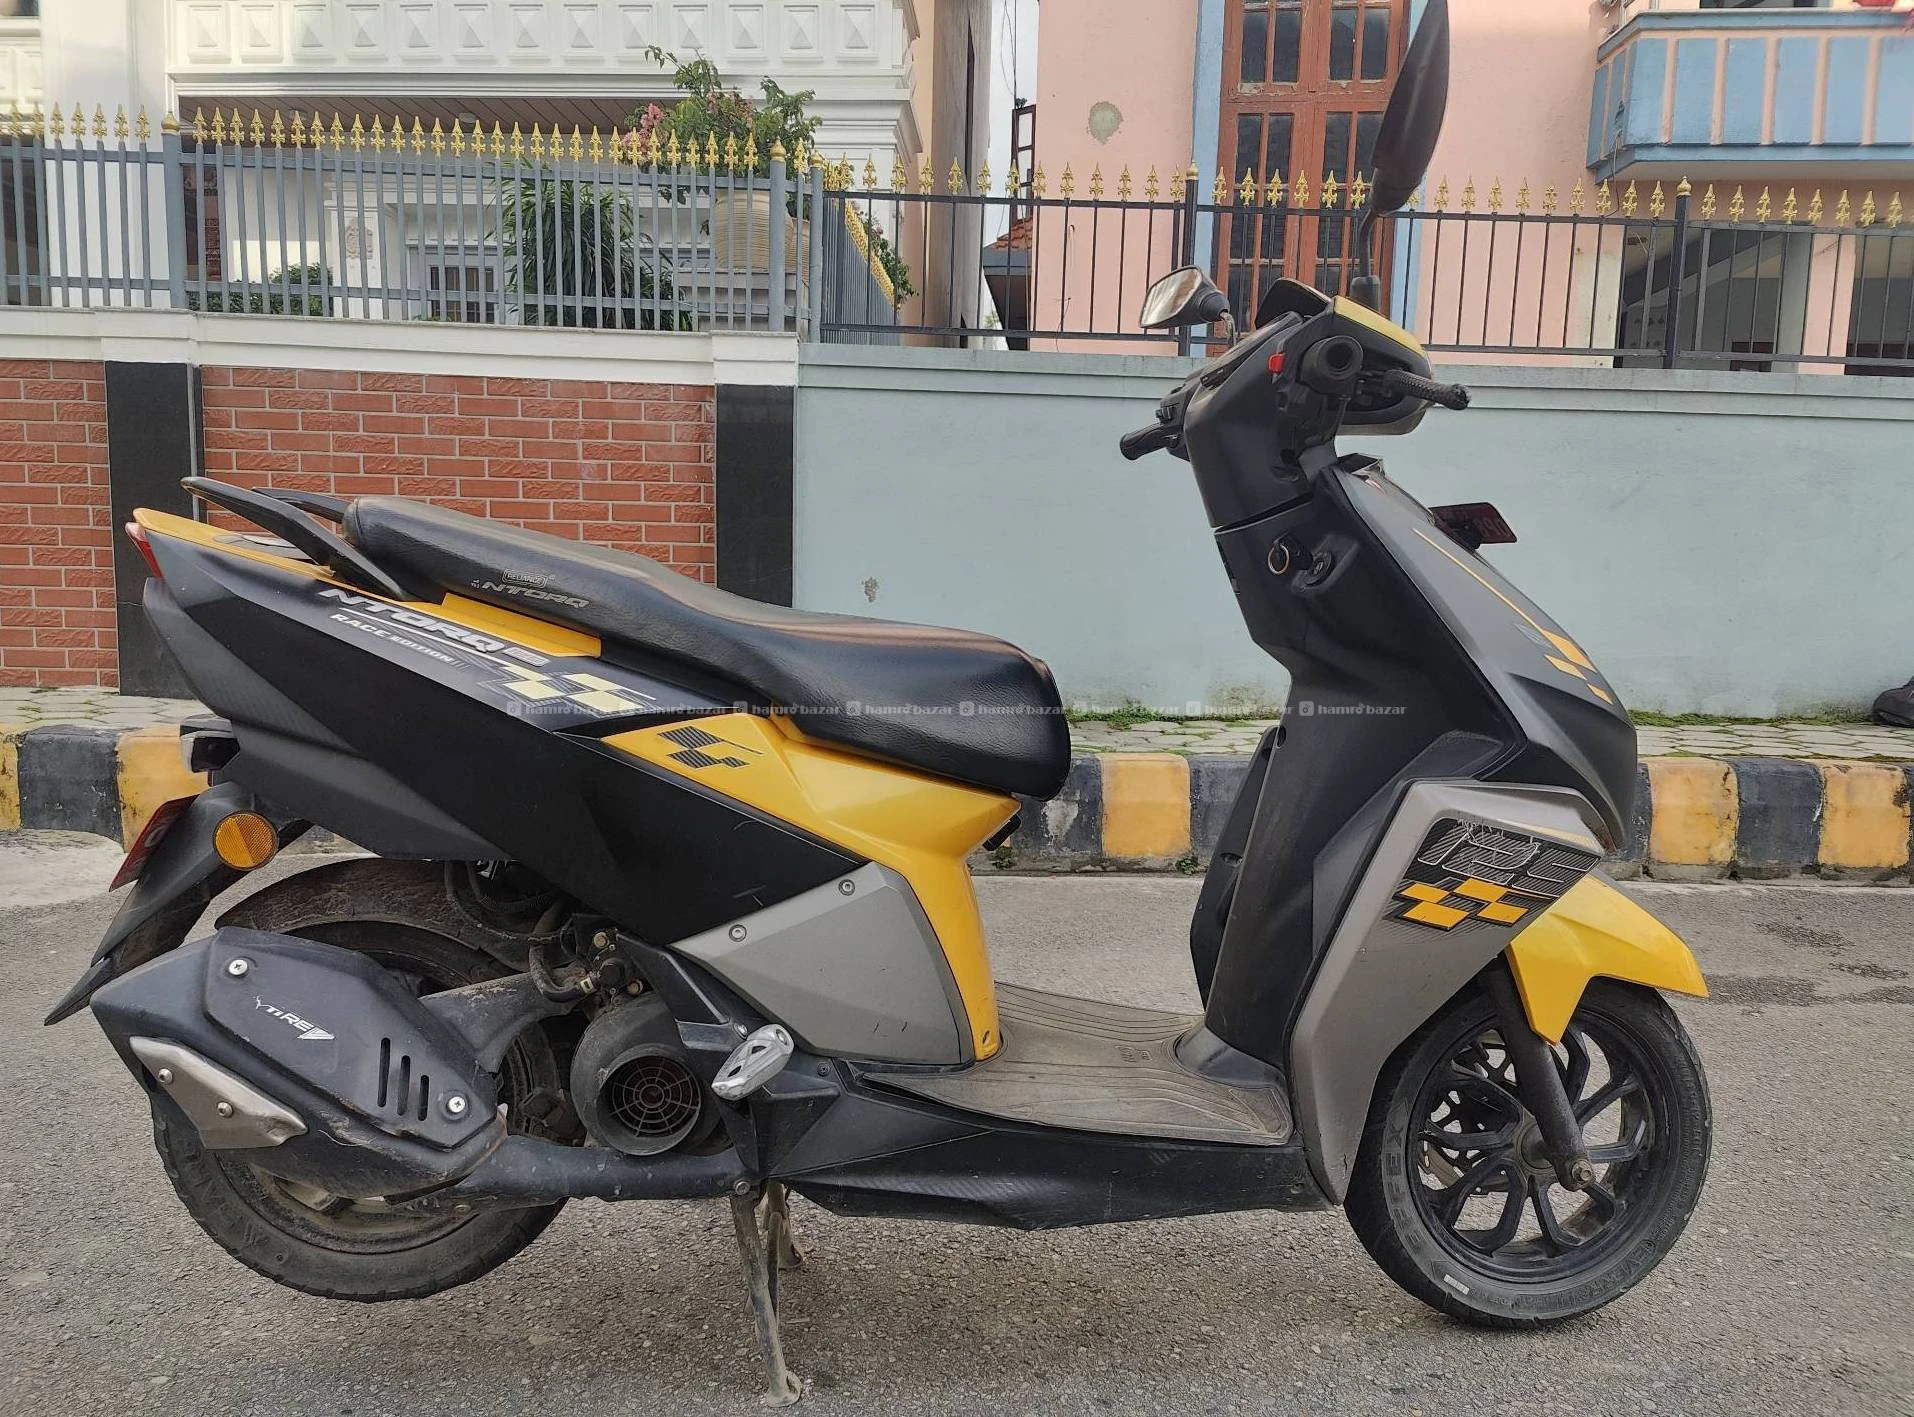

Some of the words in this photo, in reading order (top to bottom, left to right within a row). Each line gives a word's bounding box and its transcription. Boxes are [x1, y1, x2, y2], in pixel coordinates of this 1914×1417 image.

[482, 581, 591, 608] NTORQ
[318, 588, 504, 653] NTORQ
[329, 613, 391, 638] RACE
